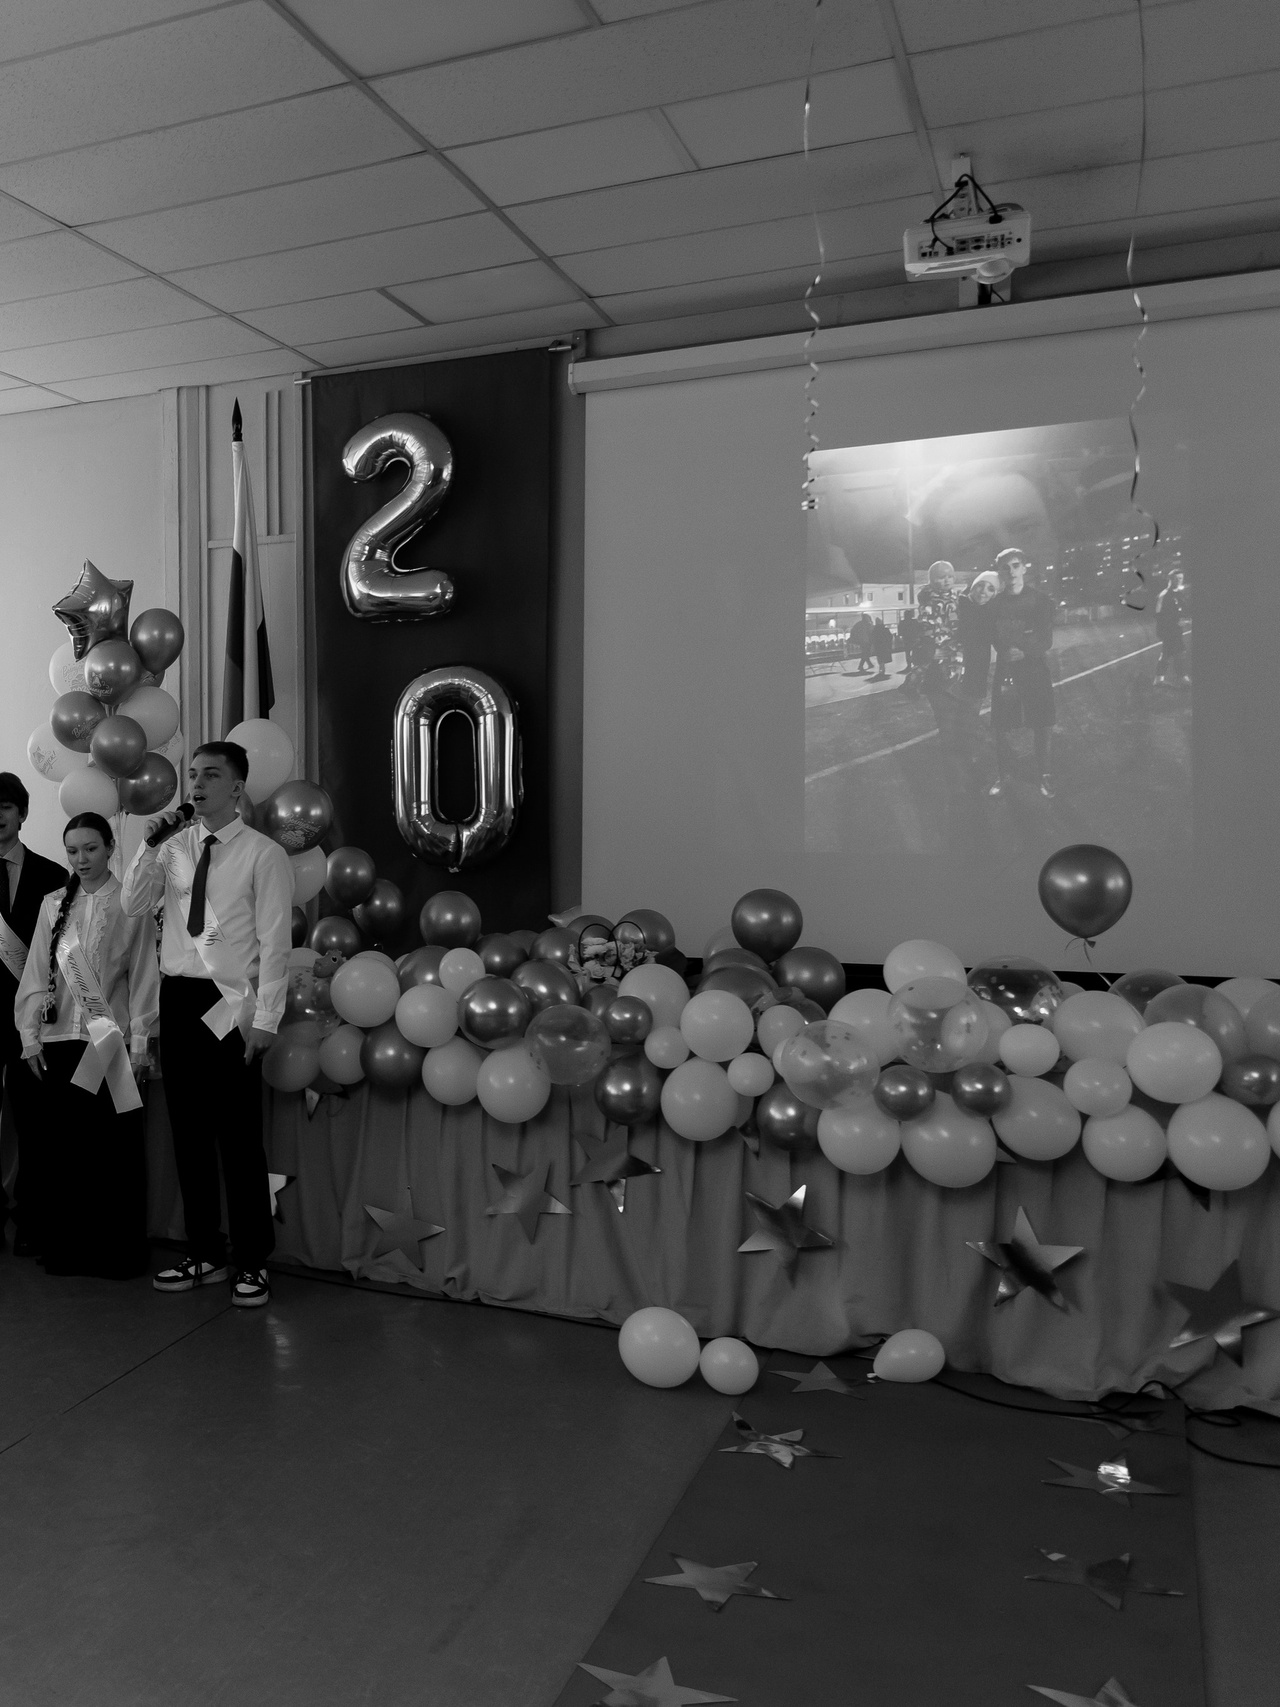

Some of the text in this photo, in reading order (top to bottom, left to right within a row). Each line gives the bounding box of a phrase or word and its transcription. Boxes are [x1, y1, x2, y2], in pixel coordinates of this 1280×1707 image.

[340, 412, 454, 623] 2
[391, 665, 523, 872] 0
[81, 995, 110, 1020] 2026
